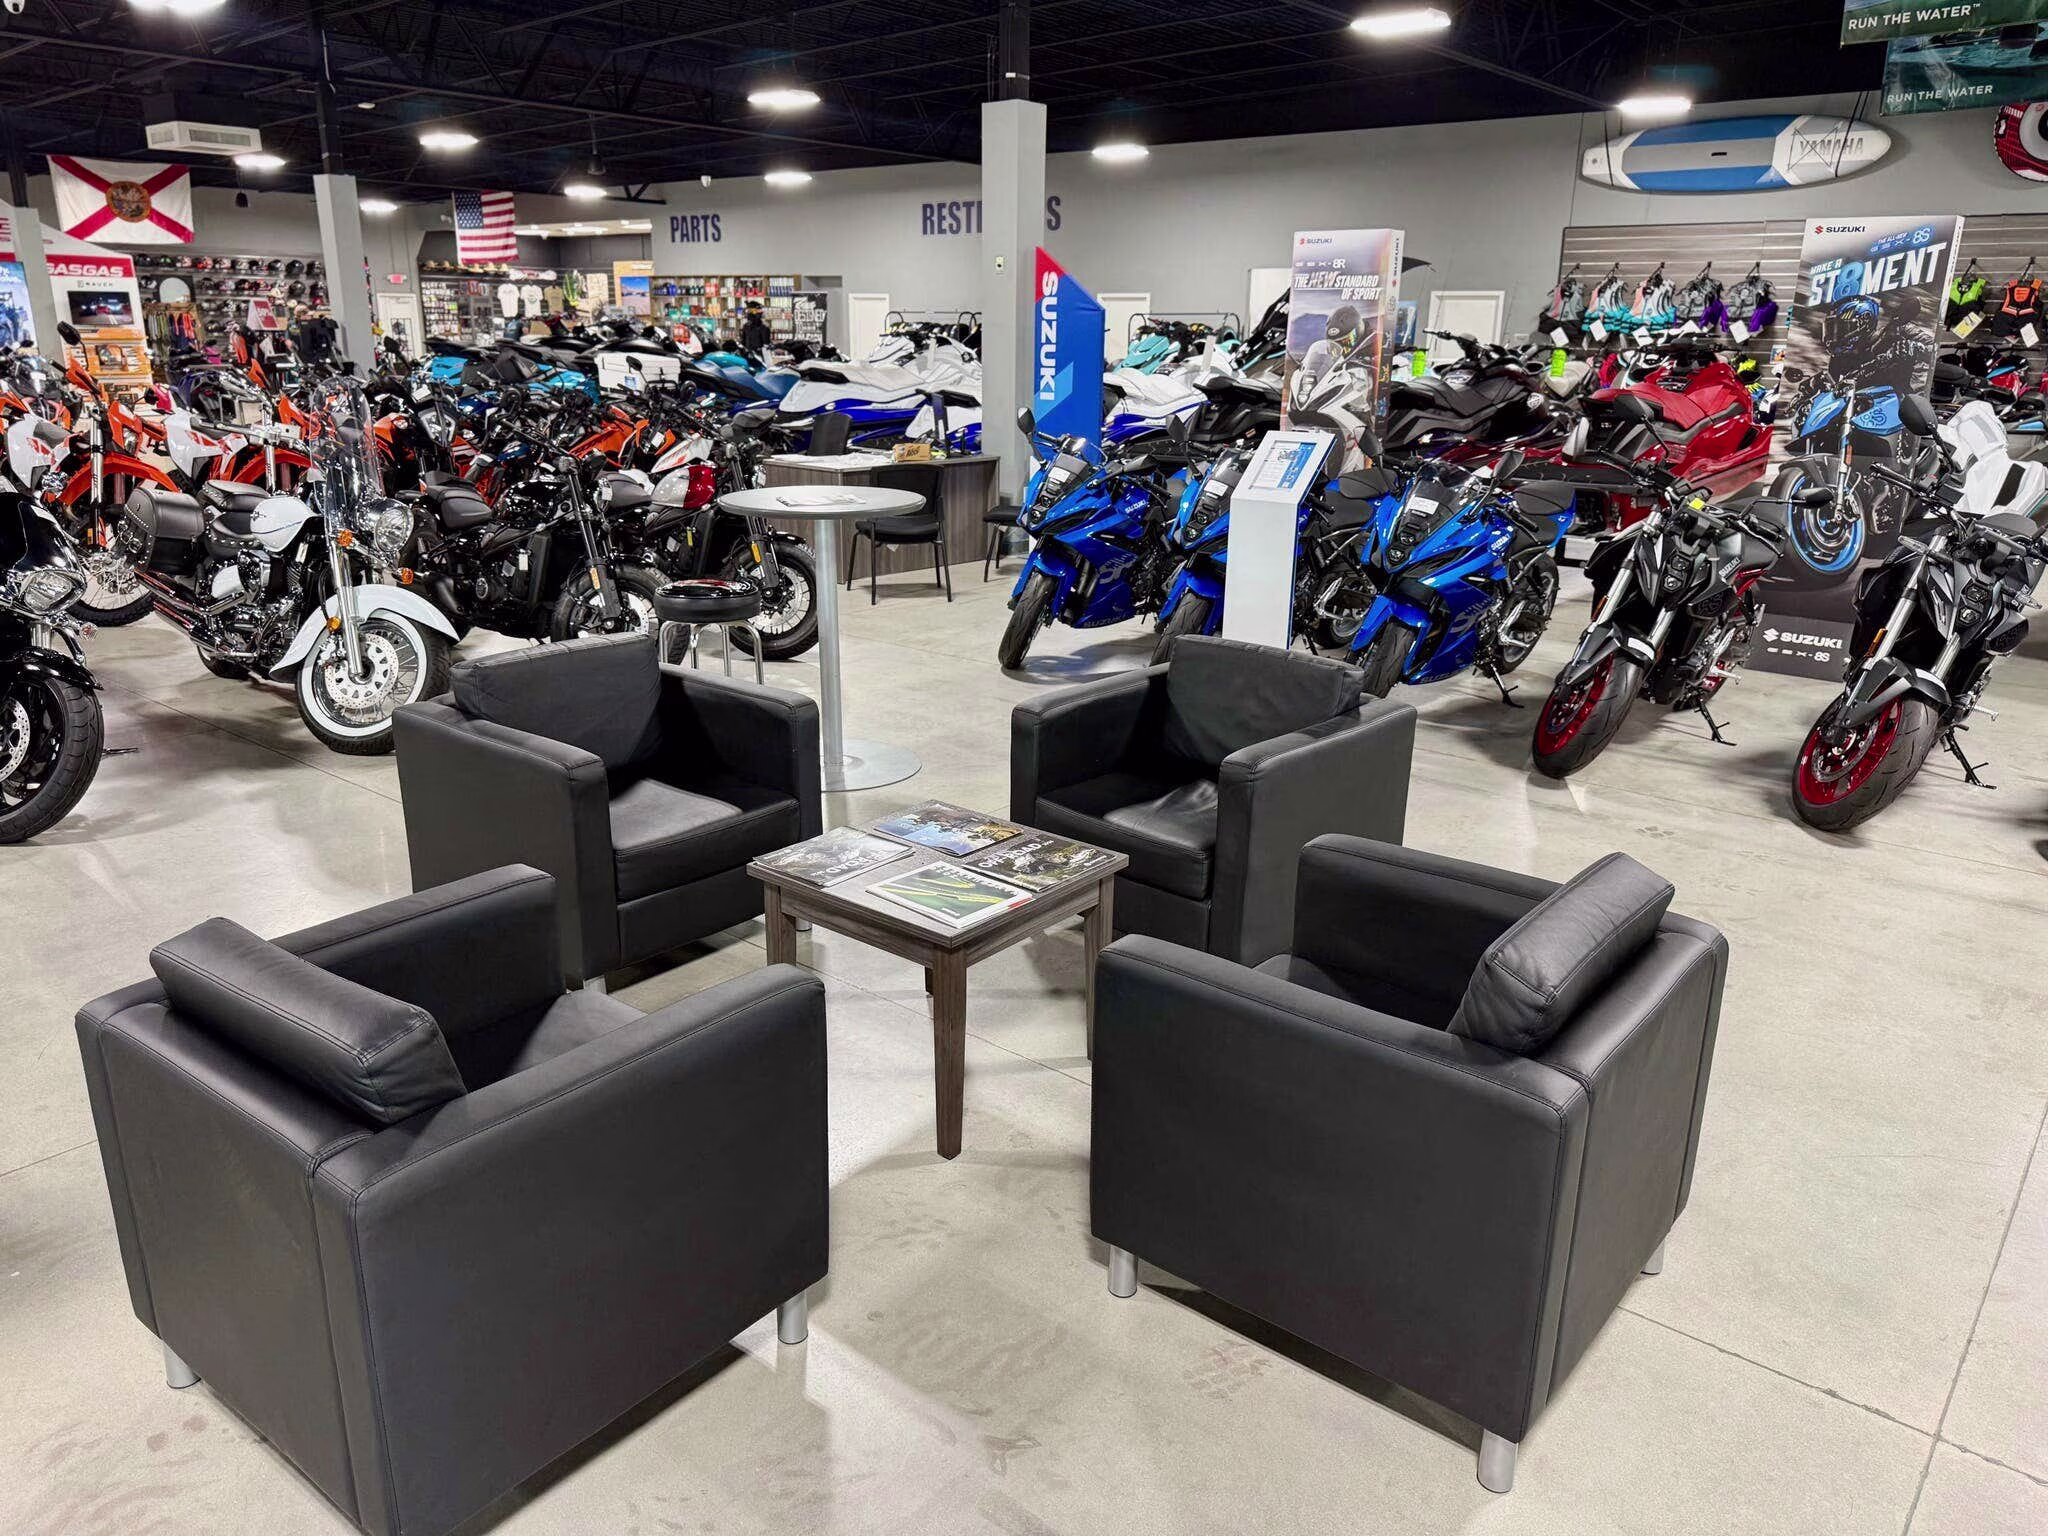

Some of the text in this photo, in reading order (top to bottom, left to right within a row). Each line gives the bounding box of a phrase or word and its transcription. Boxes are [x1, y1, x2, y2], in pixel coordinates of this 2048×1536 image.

[1848, 15, 1878, 30] RUN
[1881, 12, 1911, 26] THE
[1887, 84, 1993, 103] RUN THE WATER
[1800, 137, 1864, 155] YAMAHA
[670, 213, 721, 243] PARTS
[1808, 242, 1947, 307] ST8MENT
[1810, 258, 1843, 275] MAKE A
[1294, 271, 1380, 288] THE NEW STANDARD
[1341, 288, 1382, 300] OF SPORT
[1039, 271, 1059, 401] SUZUKI
[1125, 500, 1147, 514] SUZUKI
[1719, 557, 1741, 577] SUZUKI
[1780, 632, 1843, 649] SUZUKI
